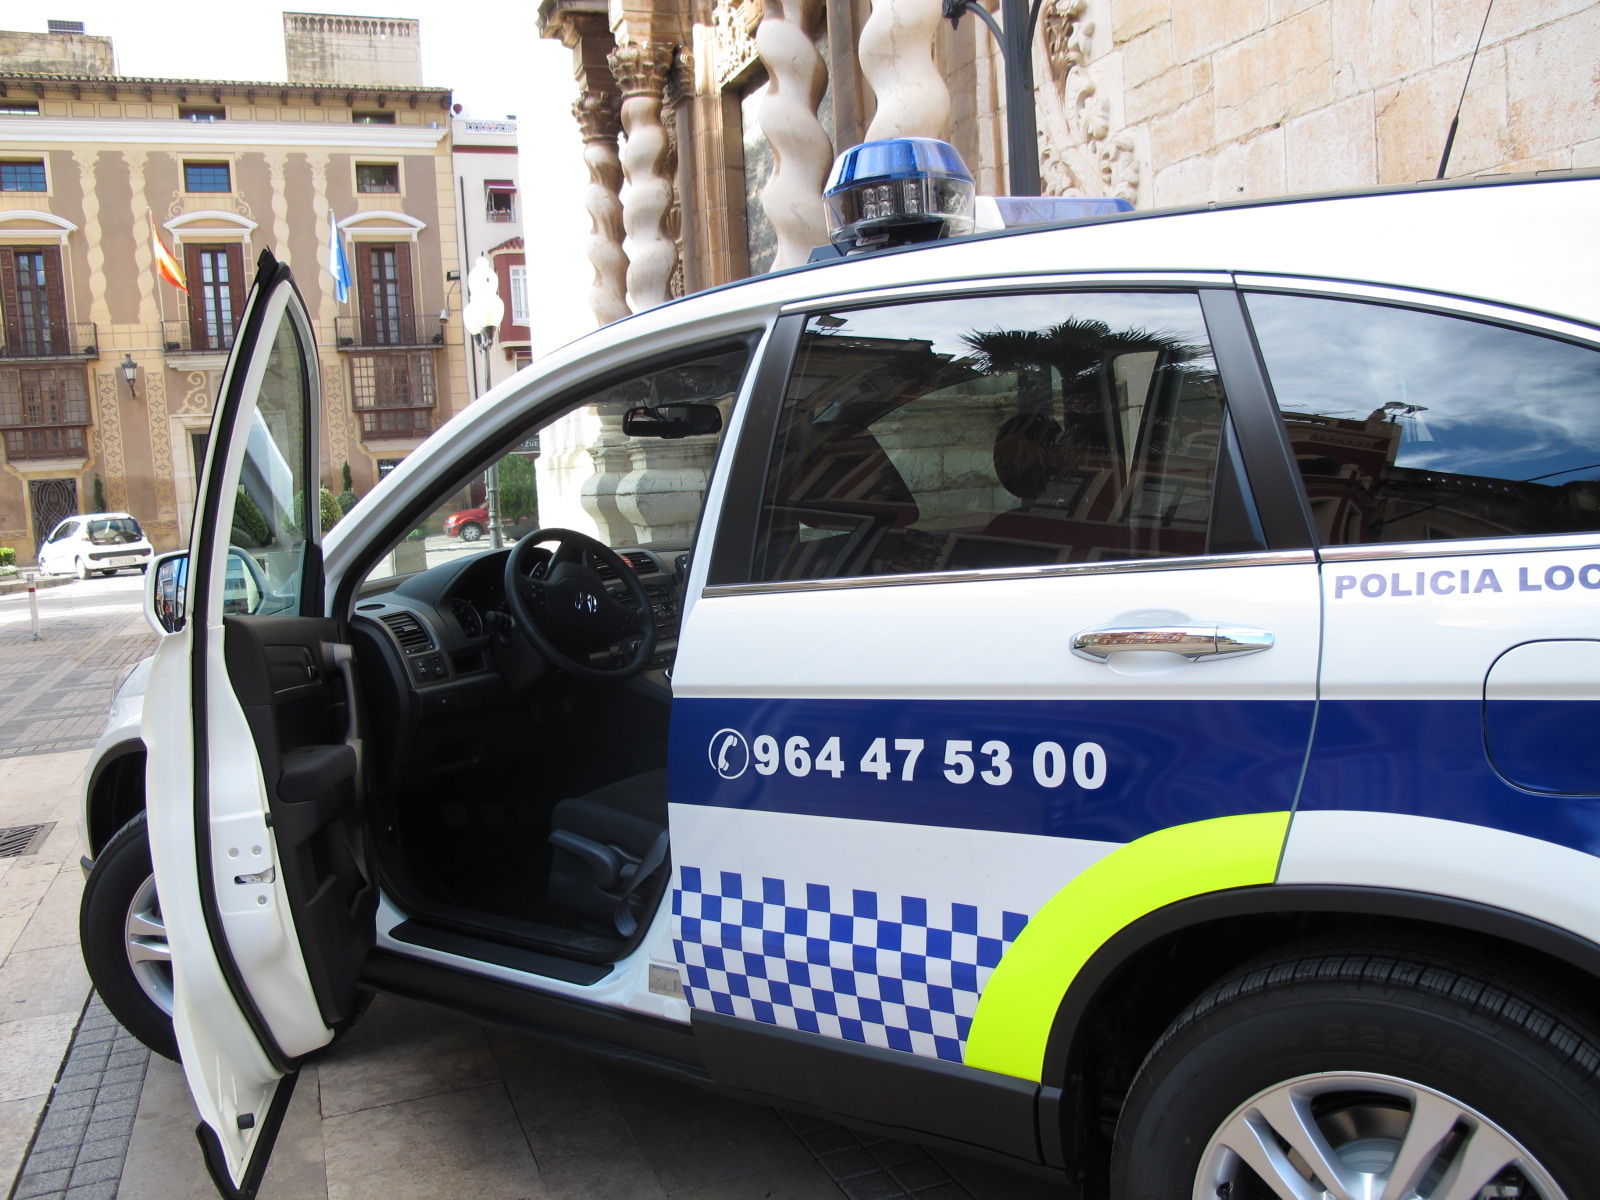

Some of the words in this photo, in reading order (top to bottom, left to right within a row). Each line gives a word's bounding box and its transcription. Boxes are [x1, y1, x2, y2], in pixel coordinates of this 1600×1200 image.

[1334, 568, 1503, 599] POLICIA
[1518, 563, 1600, 592] LOC
[753, 734, 845, 779] 964
[860, 737, 925, 782] 47
[943, 739, 1013, 786] 53
[1032, 741, 1107, 790] 00
